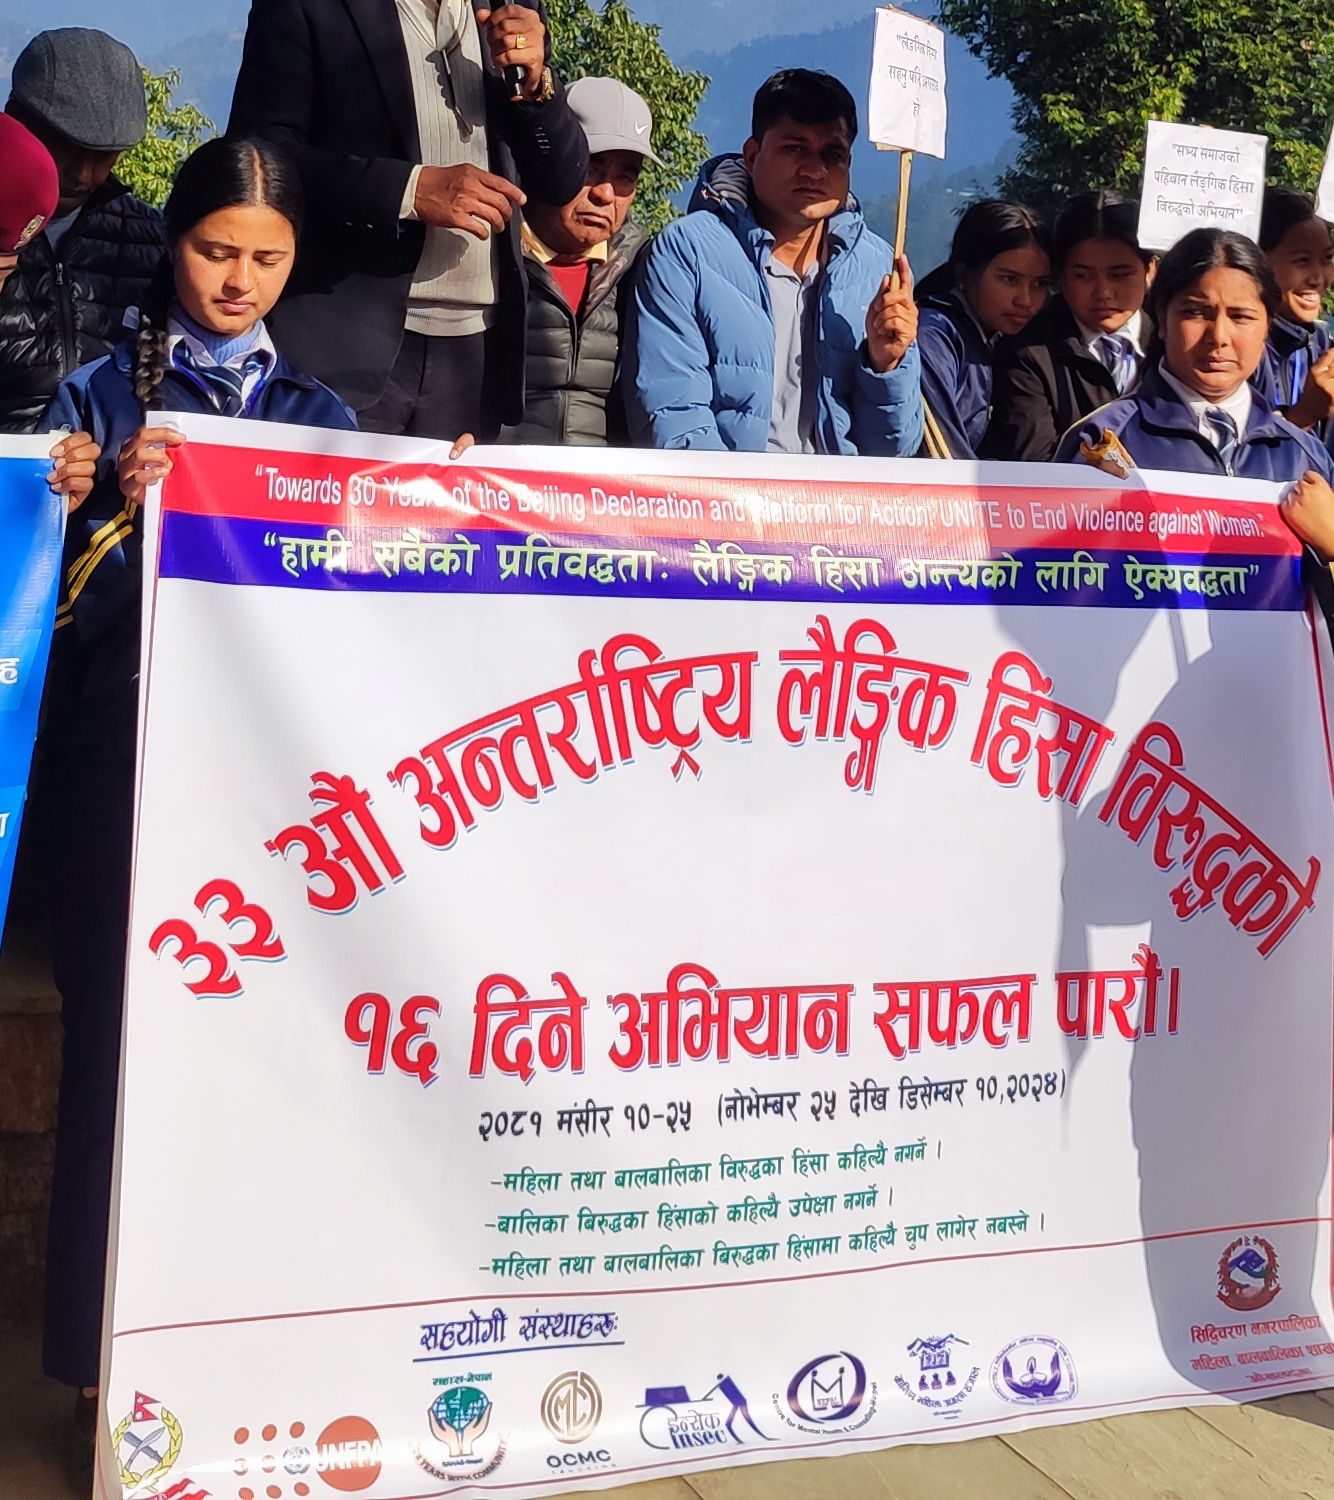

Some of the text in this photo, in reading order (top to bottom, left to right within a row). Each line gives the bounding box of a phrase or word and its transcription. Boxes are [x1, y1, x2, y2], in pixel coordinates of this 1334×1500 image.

[349, 476, 1204, 541] 30 of the Beijing Declaration and for UNITE to End Violence against
[372, 528, 1109, 594] सबैको हिंसा अन्त्यको लागि
[970, 649, 1117, 806] हिंसा
[343, 962, 1036, 1088] १६ दिने अभियान सफल
[478, 1075, 968, 1141] २०८१ मंसीर २५ देखि डिसेम्बर
[570, 1140, 888, 1191] तथा बालबालिका हिंसा कहिल्यै
[656, 1192, 837, 1231] हिंसाको कहिल्यै उपेक्षा
[558, 1209, 1030, 1276] तथा बालबालिका हिंसामा कहिल्यै चुप लागेर नबस्ने
[420, 1308, 508, 1353] सहयोगी
[316, 1437, 383, 1472] UNFPA
[546, 1448, 612, 1469] OCMC
[669, 1427, 728, 1449] insec
